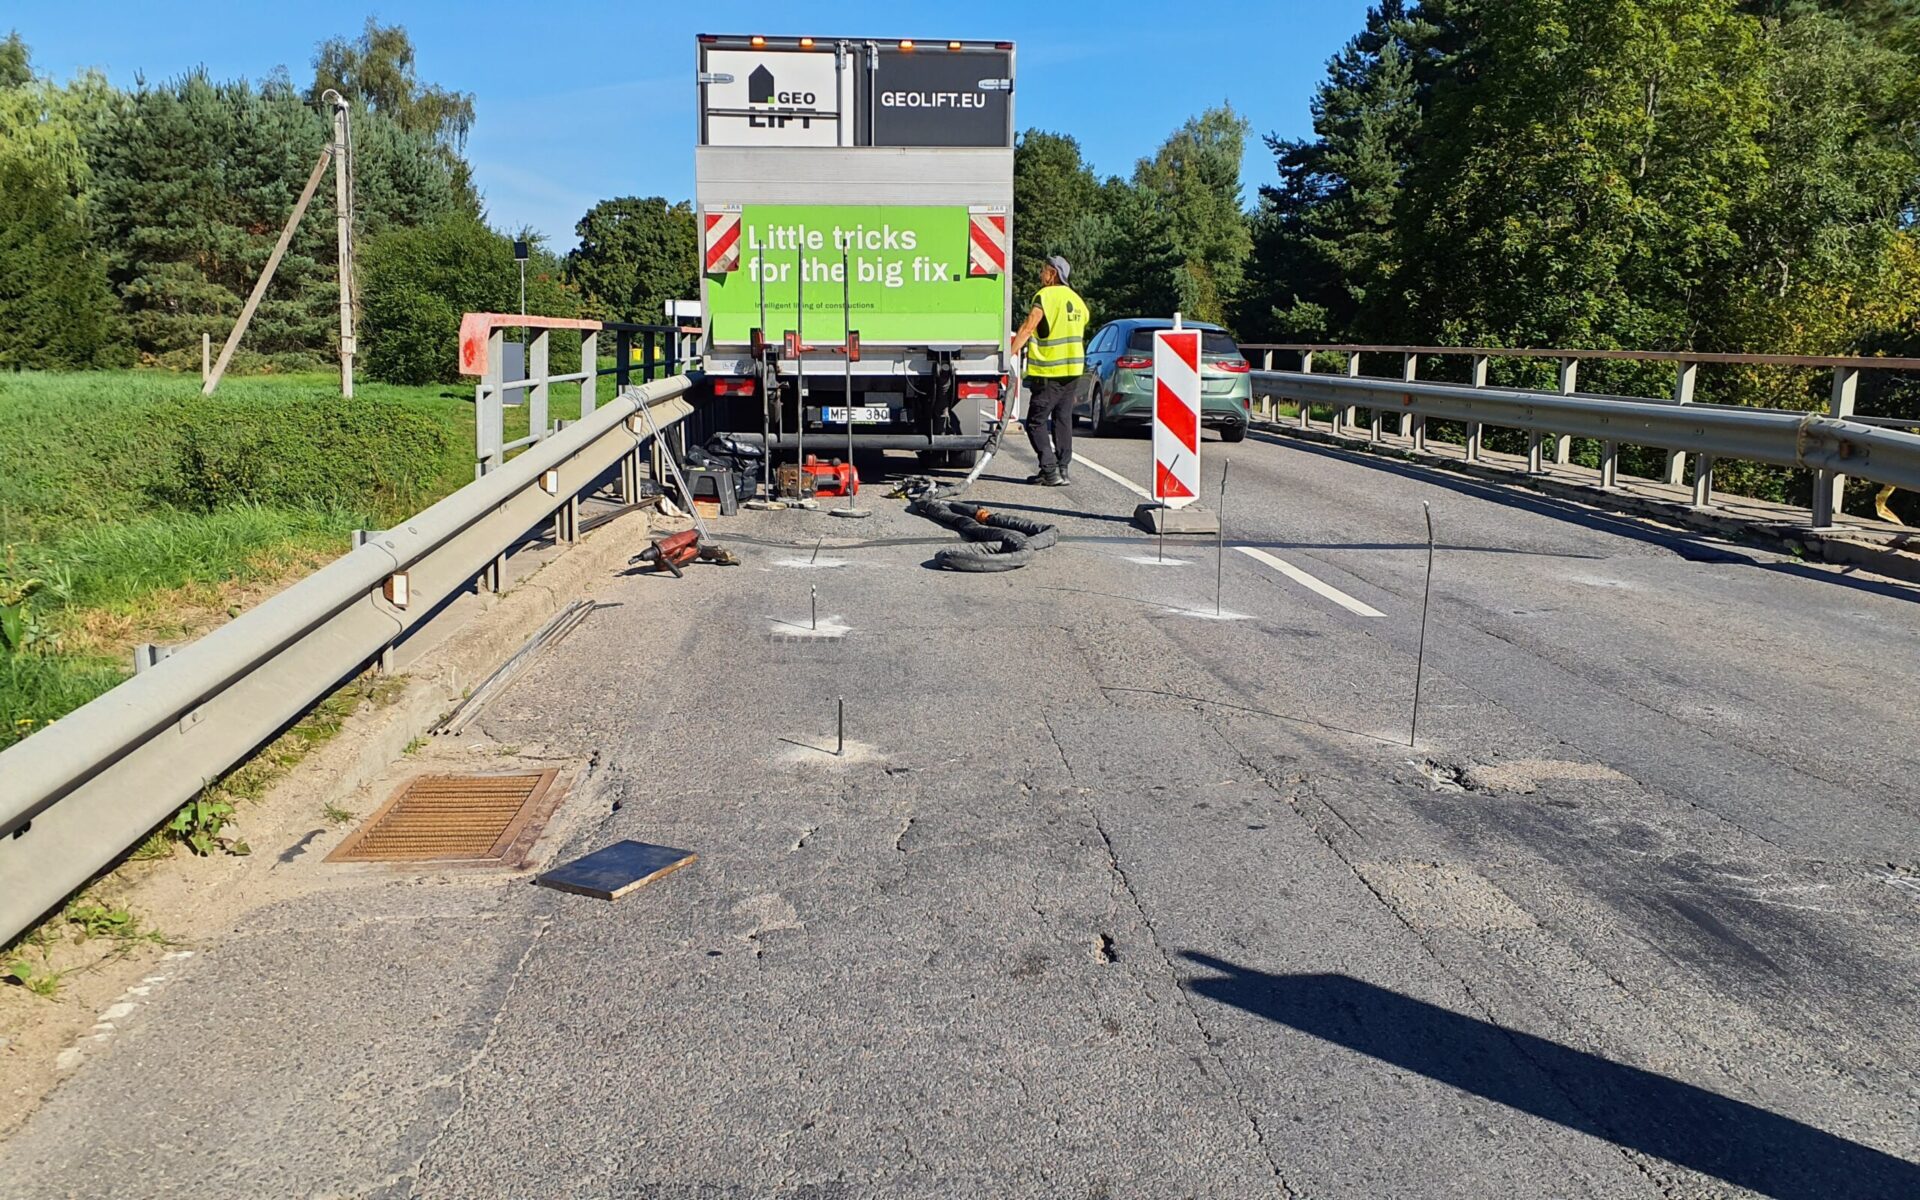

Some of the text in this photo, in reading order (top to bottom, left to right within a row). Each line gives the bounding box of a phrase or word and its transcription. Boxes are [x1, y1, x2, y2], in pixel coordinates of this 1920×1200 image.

[778, 92, 816, 104] GEO
[881, 91, 986, 108] GEOLIFT.EU
[749, 106, 816, 128] LIFT
[748, 224, 917, 250] Little tricks
[748, 256, 791, 282] for
[800, 256, 847, 282] the
[857, 256, 904, 288] big
